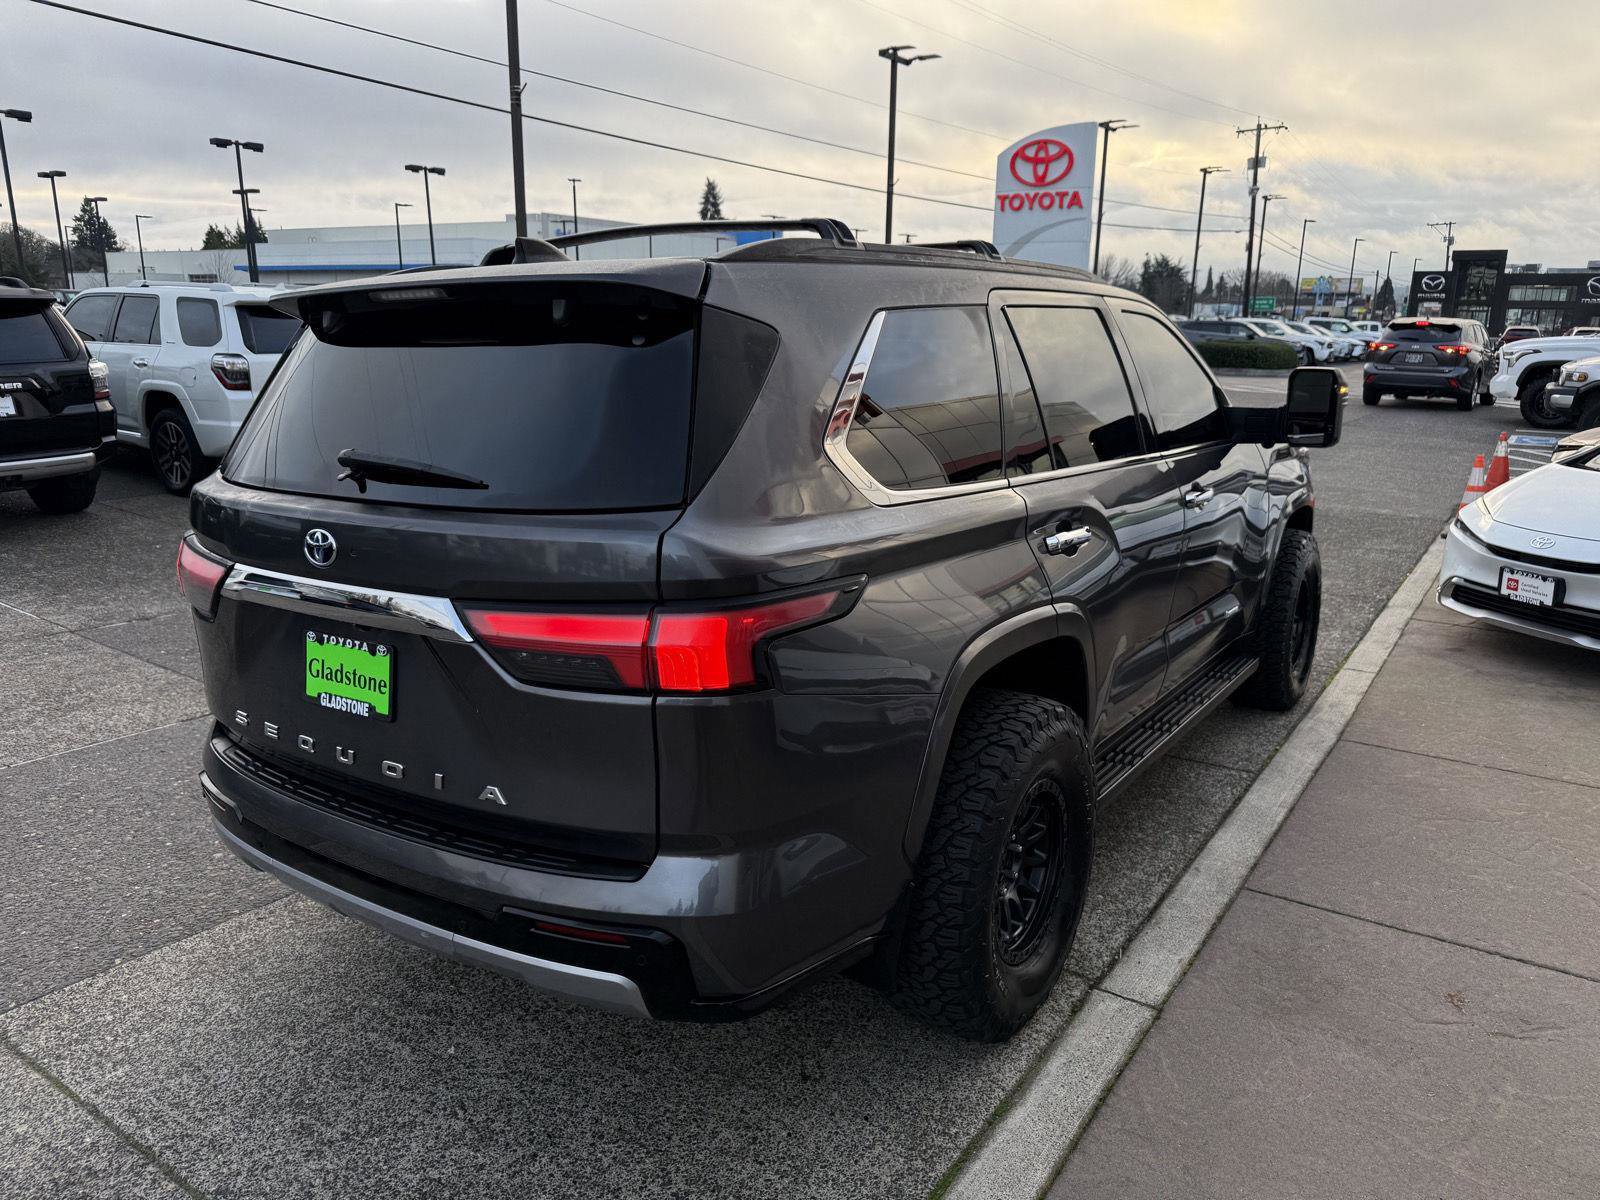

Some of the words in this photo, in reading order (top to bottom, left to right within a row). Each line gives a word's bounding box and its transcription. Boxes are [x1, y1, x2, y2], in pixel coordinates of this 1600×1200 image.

[997, 191, 1083, 212] TOYOTA
[1514, 570, 1543, 581] TOYOTA
[1509, 593, 1541, 606] GLADSTONE
[322, 634, 369, 652] TOYOTA
[308, 657, 388, 695] Gladstone
[320, 692, 369, 717] GLADSTONE
[234, 709, 507, 806] SEQUOIA
